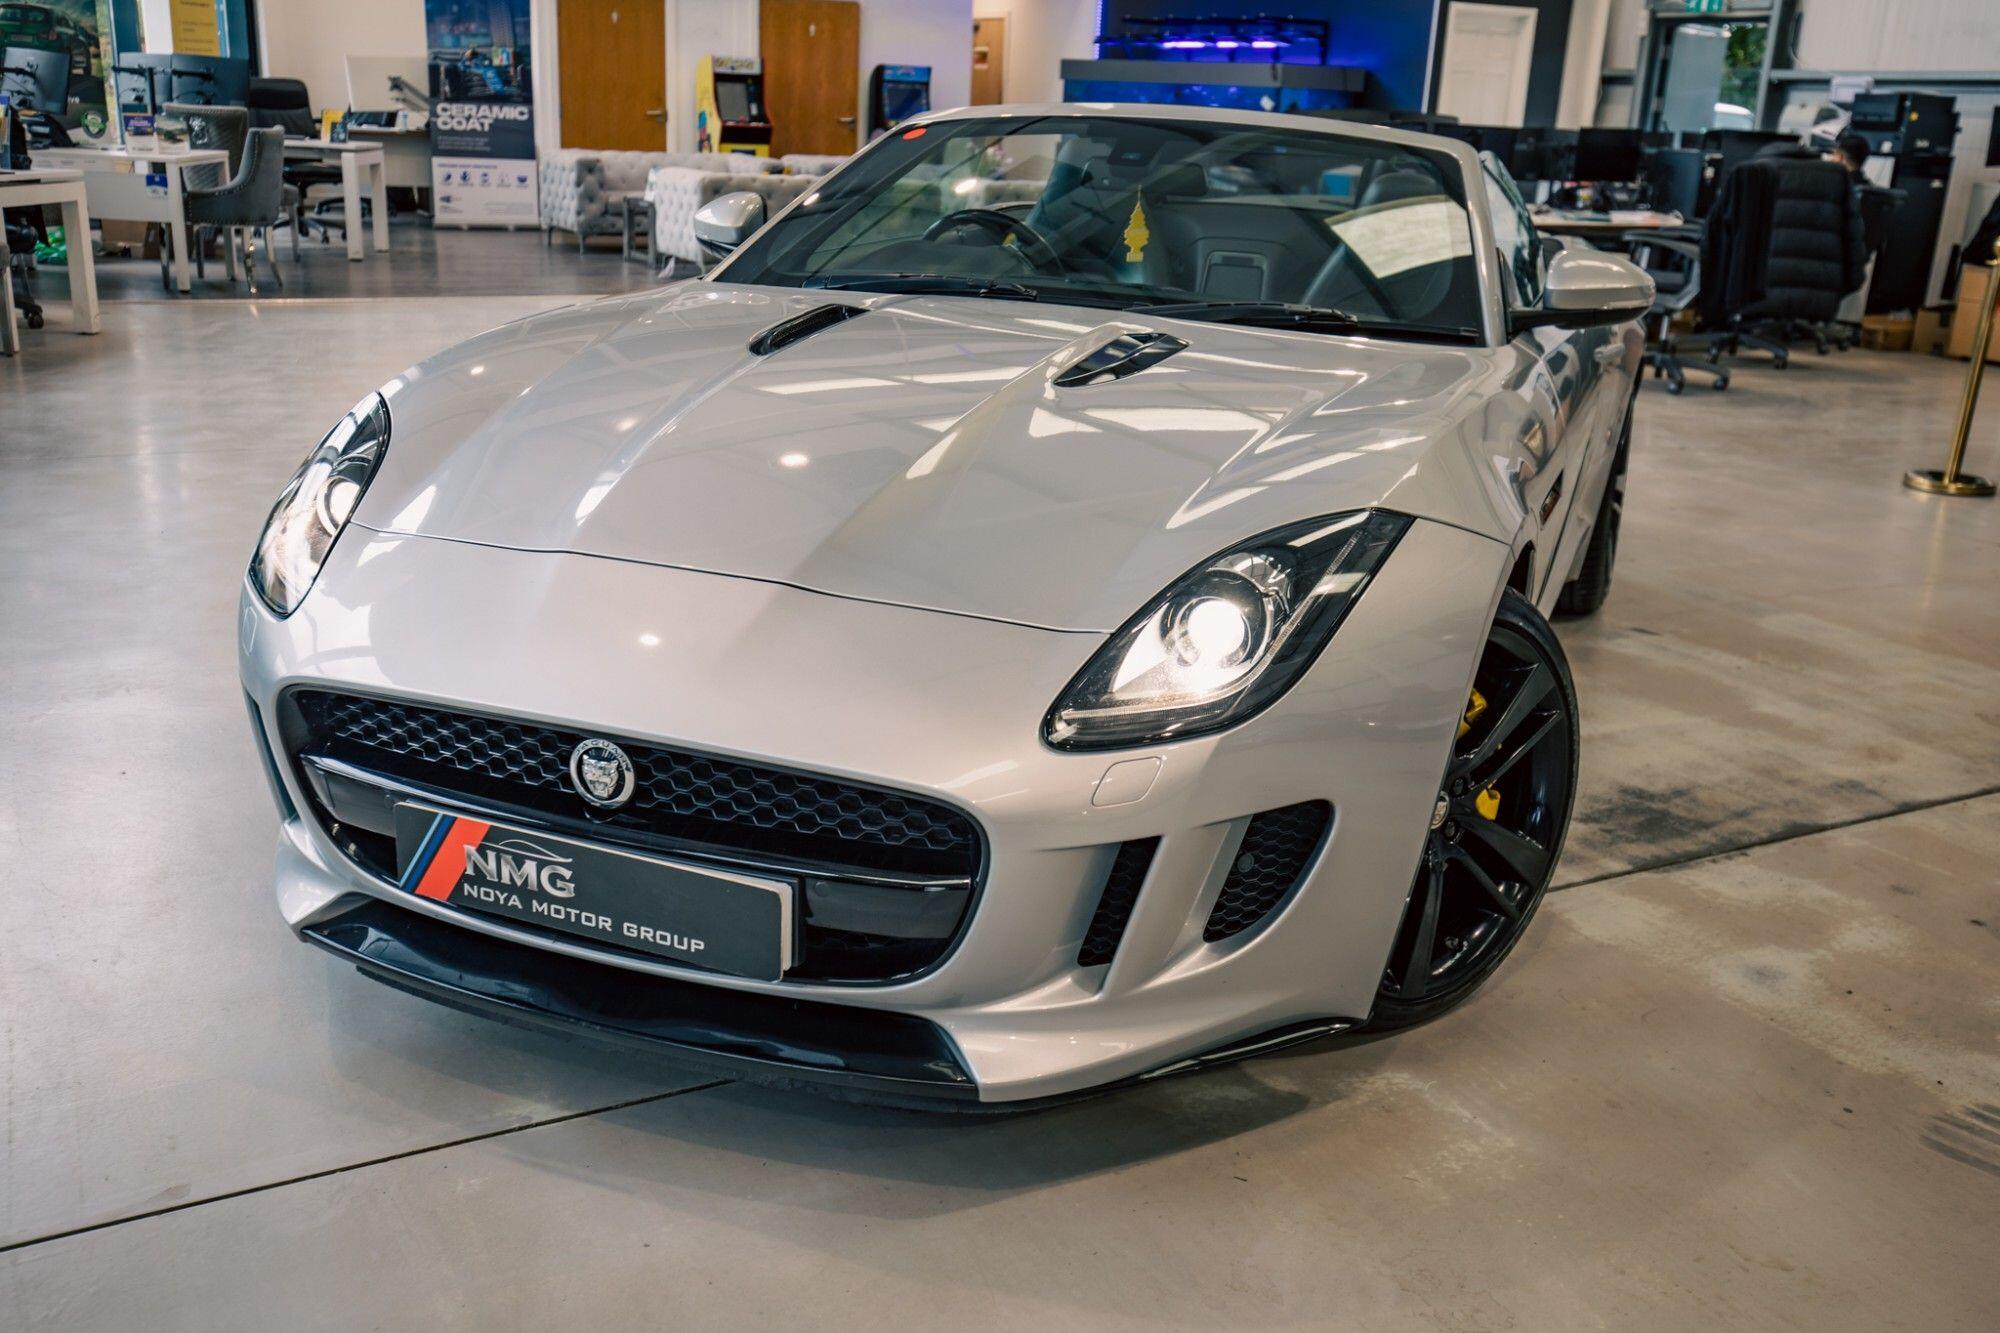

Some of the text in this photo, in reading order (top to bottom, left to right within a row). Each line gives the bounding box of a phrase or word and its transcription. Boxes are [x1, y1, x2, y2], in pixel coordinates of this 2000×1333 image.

[436, 102, 529, 120] CERAMIC
[437, 117, 493, 132] COAT
[575, 739, 632, 773] JAGUAR
[463, 844, 576, 898] NMG
[463, 883, 705, 952] NOYA MOTOR GROUP
